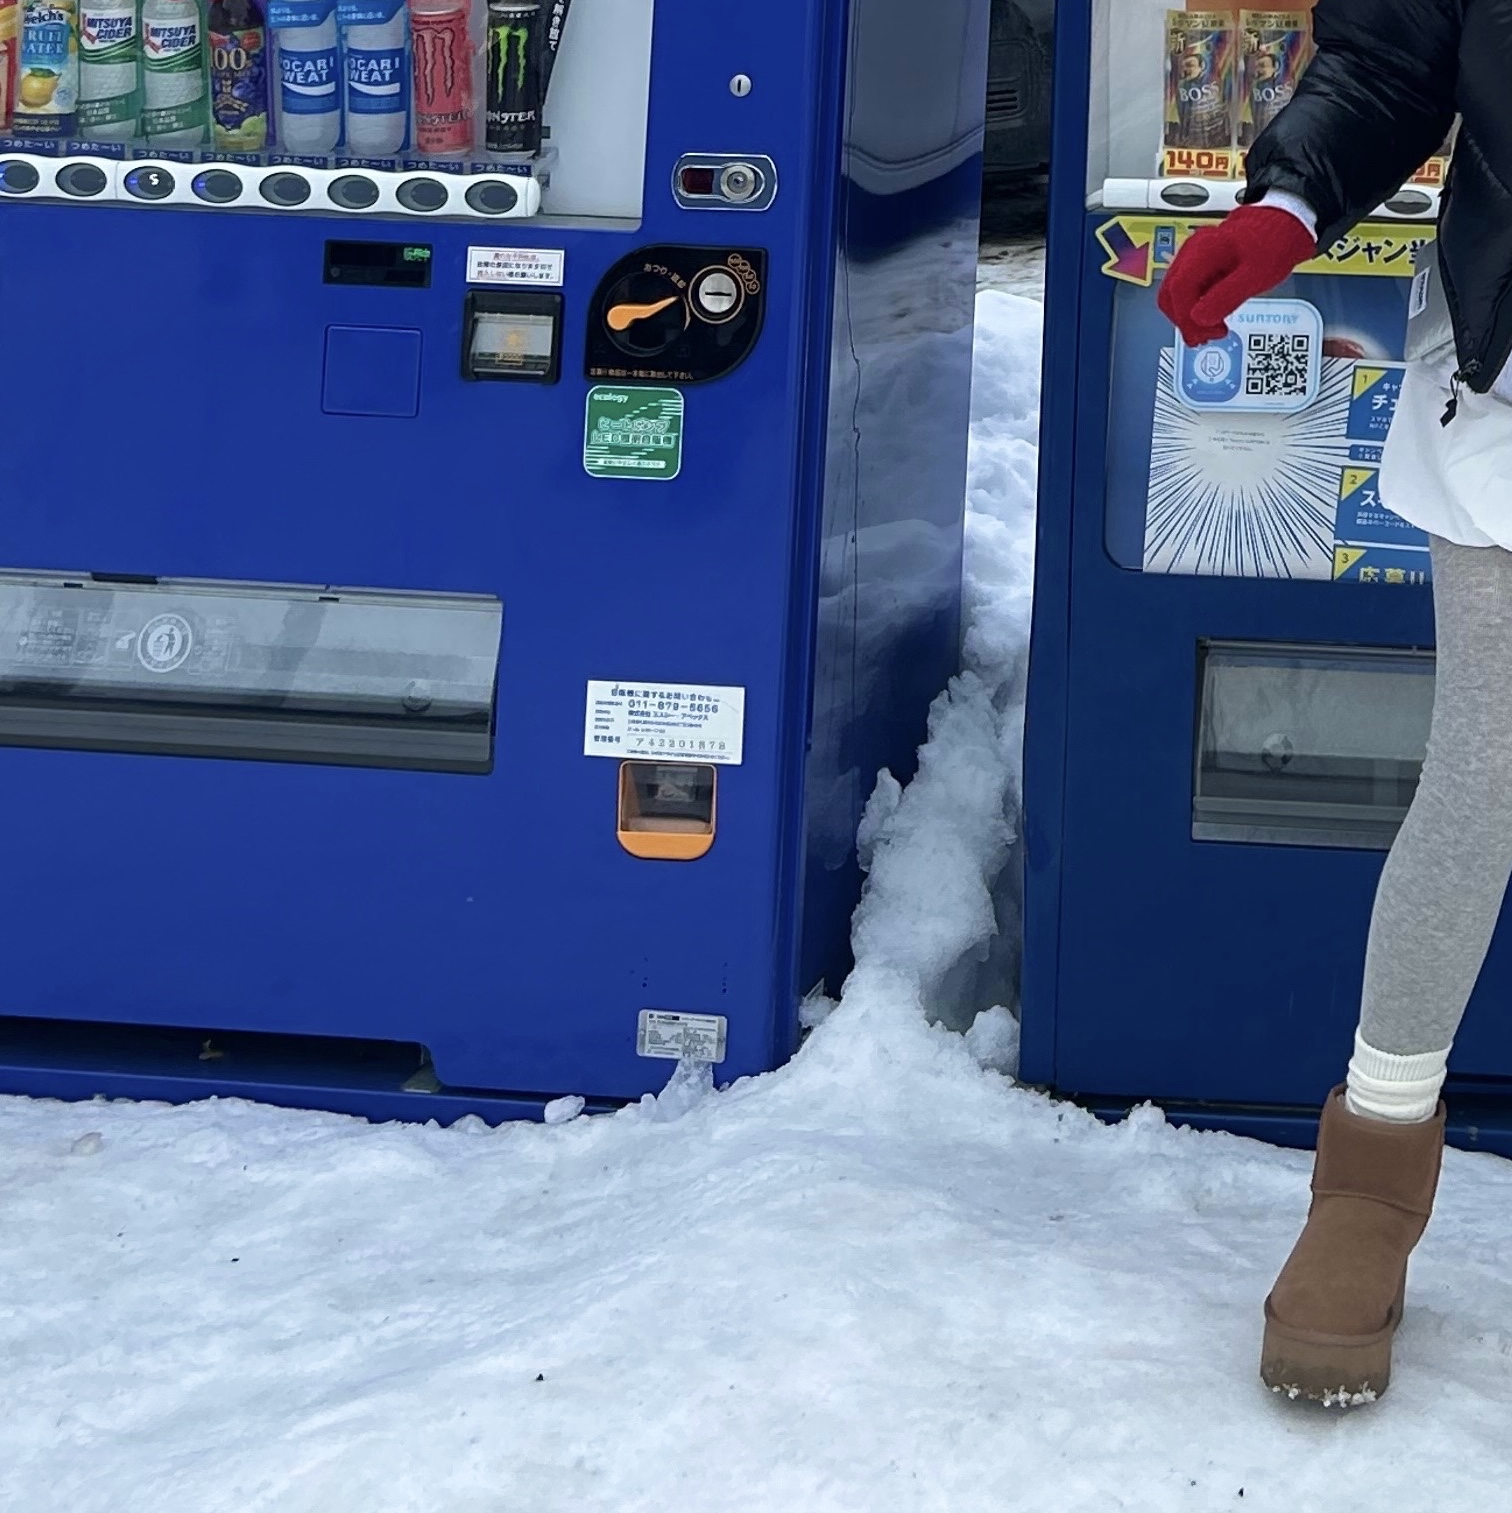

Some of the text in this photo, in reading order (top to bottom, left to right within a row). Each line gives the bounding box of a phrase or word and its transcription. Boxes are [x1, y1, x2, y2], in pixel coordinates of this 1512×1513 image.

[87, 16, 132, 28] MITSUYA
[96, 28, 132, 40] CIDER
[150, 25, 196, 37] MITSUYA
[161, 37, 196, 49] CIDER
[1179, 81, 1219, 102] BOSS
[1253, 82, 1293, 102] BOSS
[1166, 151, 1229, 169] 140円
[1238, 312, 1300, 325] SUNTORY
[1350, 474, 1358, 485] 2
[1341, 552, 1350, 564] 3
